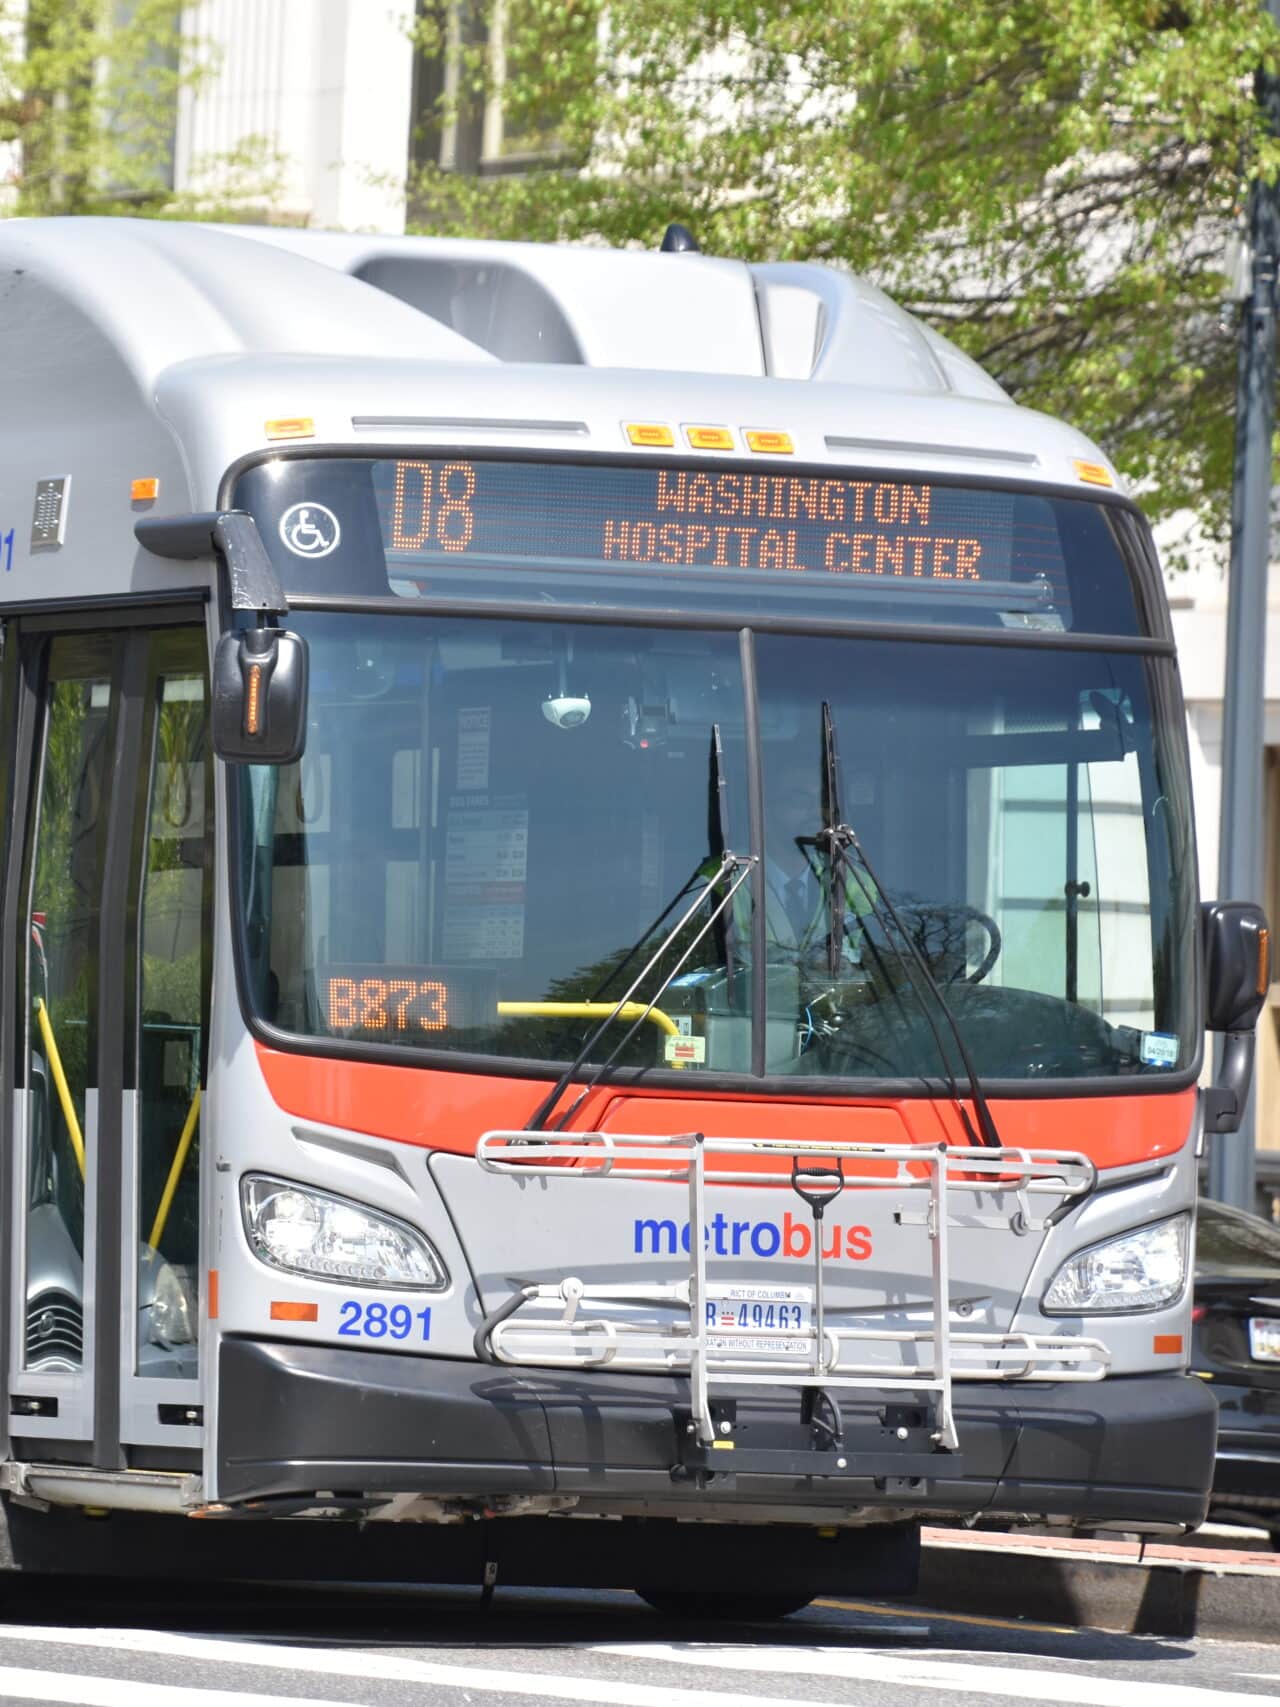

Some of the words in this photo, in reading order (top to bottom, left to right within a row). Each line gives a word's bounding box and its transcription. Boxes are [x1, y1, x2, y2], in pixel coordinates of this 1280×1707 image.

[390, 459, 477, 553] D8
[655, 470, 931, 526] WASHINGTON
[601, 518, 806, 572] HOSPITAL
[823, 531, 982, 581] CENTER
[329, 978, 448, 1031] B873
[634, 1212, 873, 1260] metrobus
[338, 1301, 432, 1341] 2891
[738, 1303, 802, 1329] 49463
